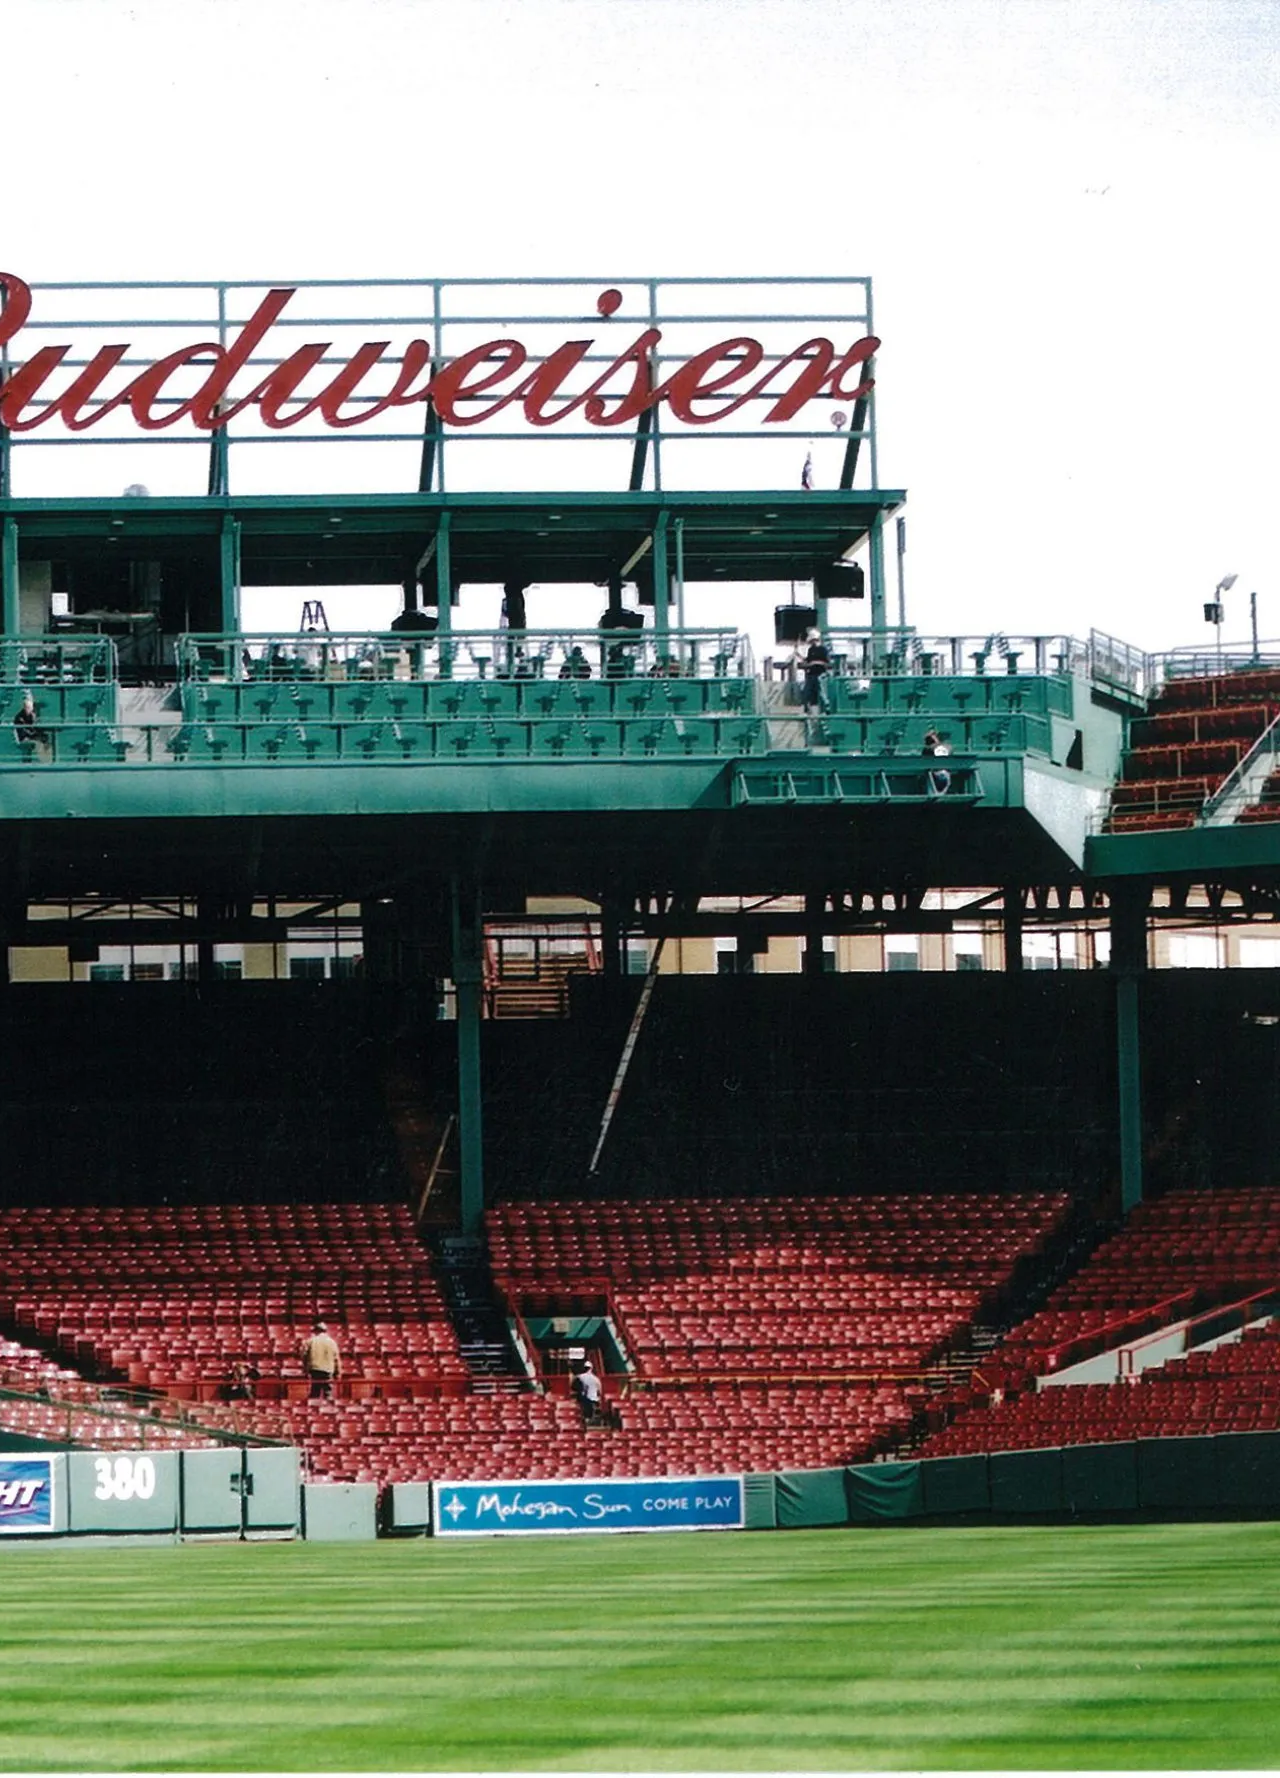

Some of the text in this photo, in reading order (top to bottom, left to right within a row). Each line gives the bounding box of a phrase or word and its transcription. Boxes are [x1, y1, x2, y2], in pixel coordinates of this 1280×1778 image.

[94, 1456, 157, 1501] 380
[476, 1492, 733, 1522] Mohegan Sun COME PLAY
